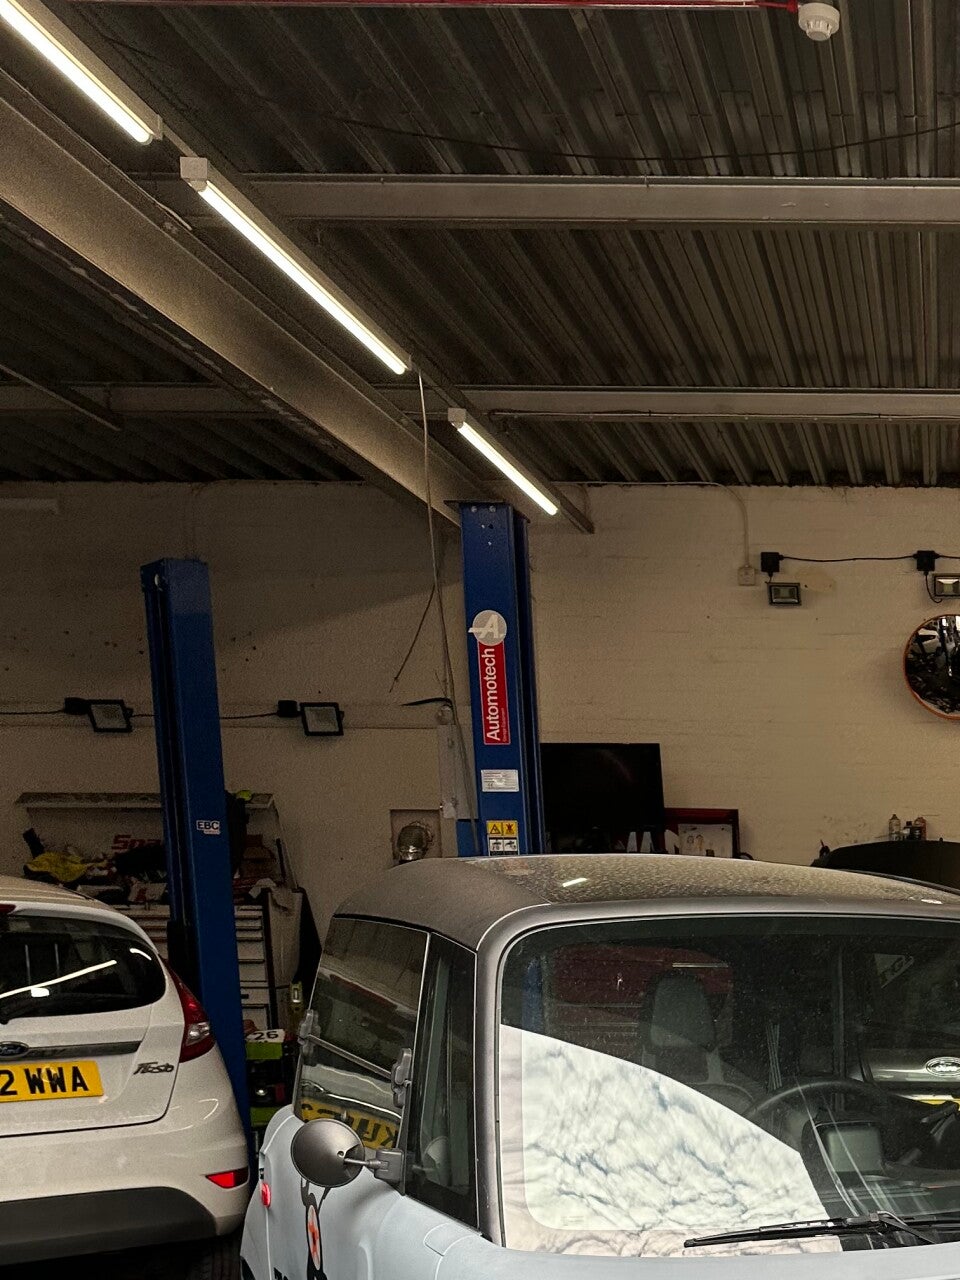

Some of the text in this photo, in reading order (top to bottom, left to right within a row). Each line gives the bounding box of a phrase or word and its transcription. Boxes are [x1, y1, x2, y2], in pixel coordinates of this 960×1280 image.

[482, 648, 501, 741] Automotech
[197, 821, 219, 830] EBC
[24, 1066, 89, 1094] WWA
